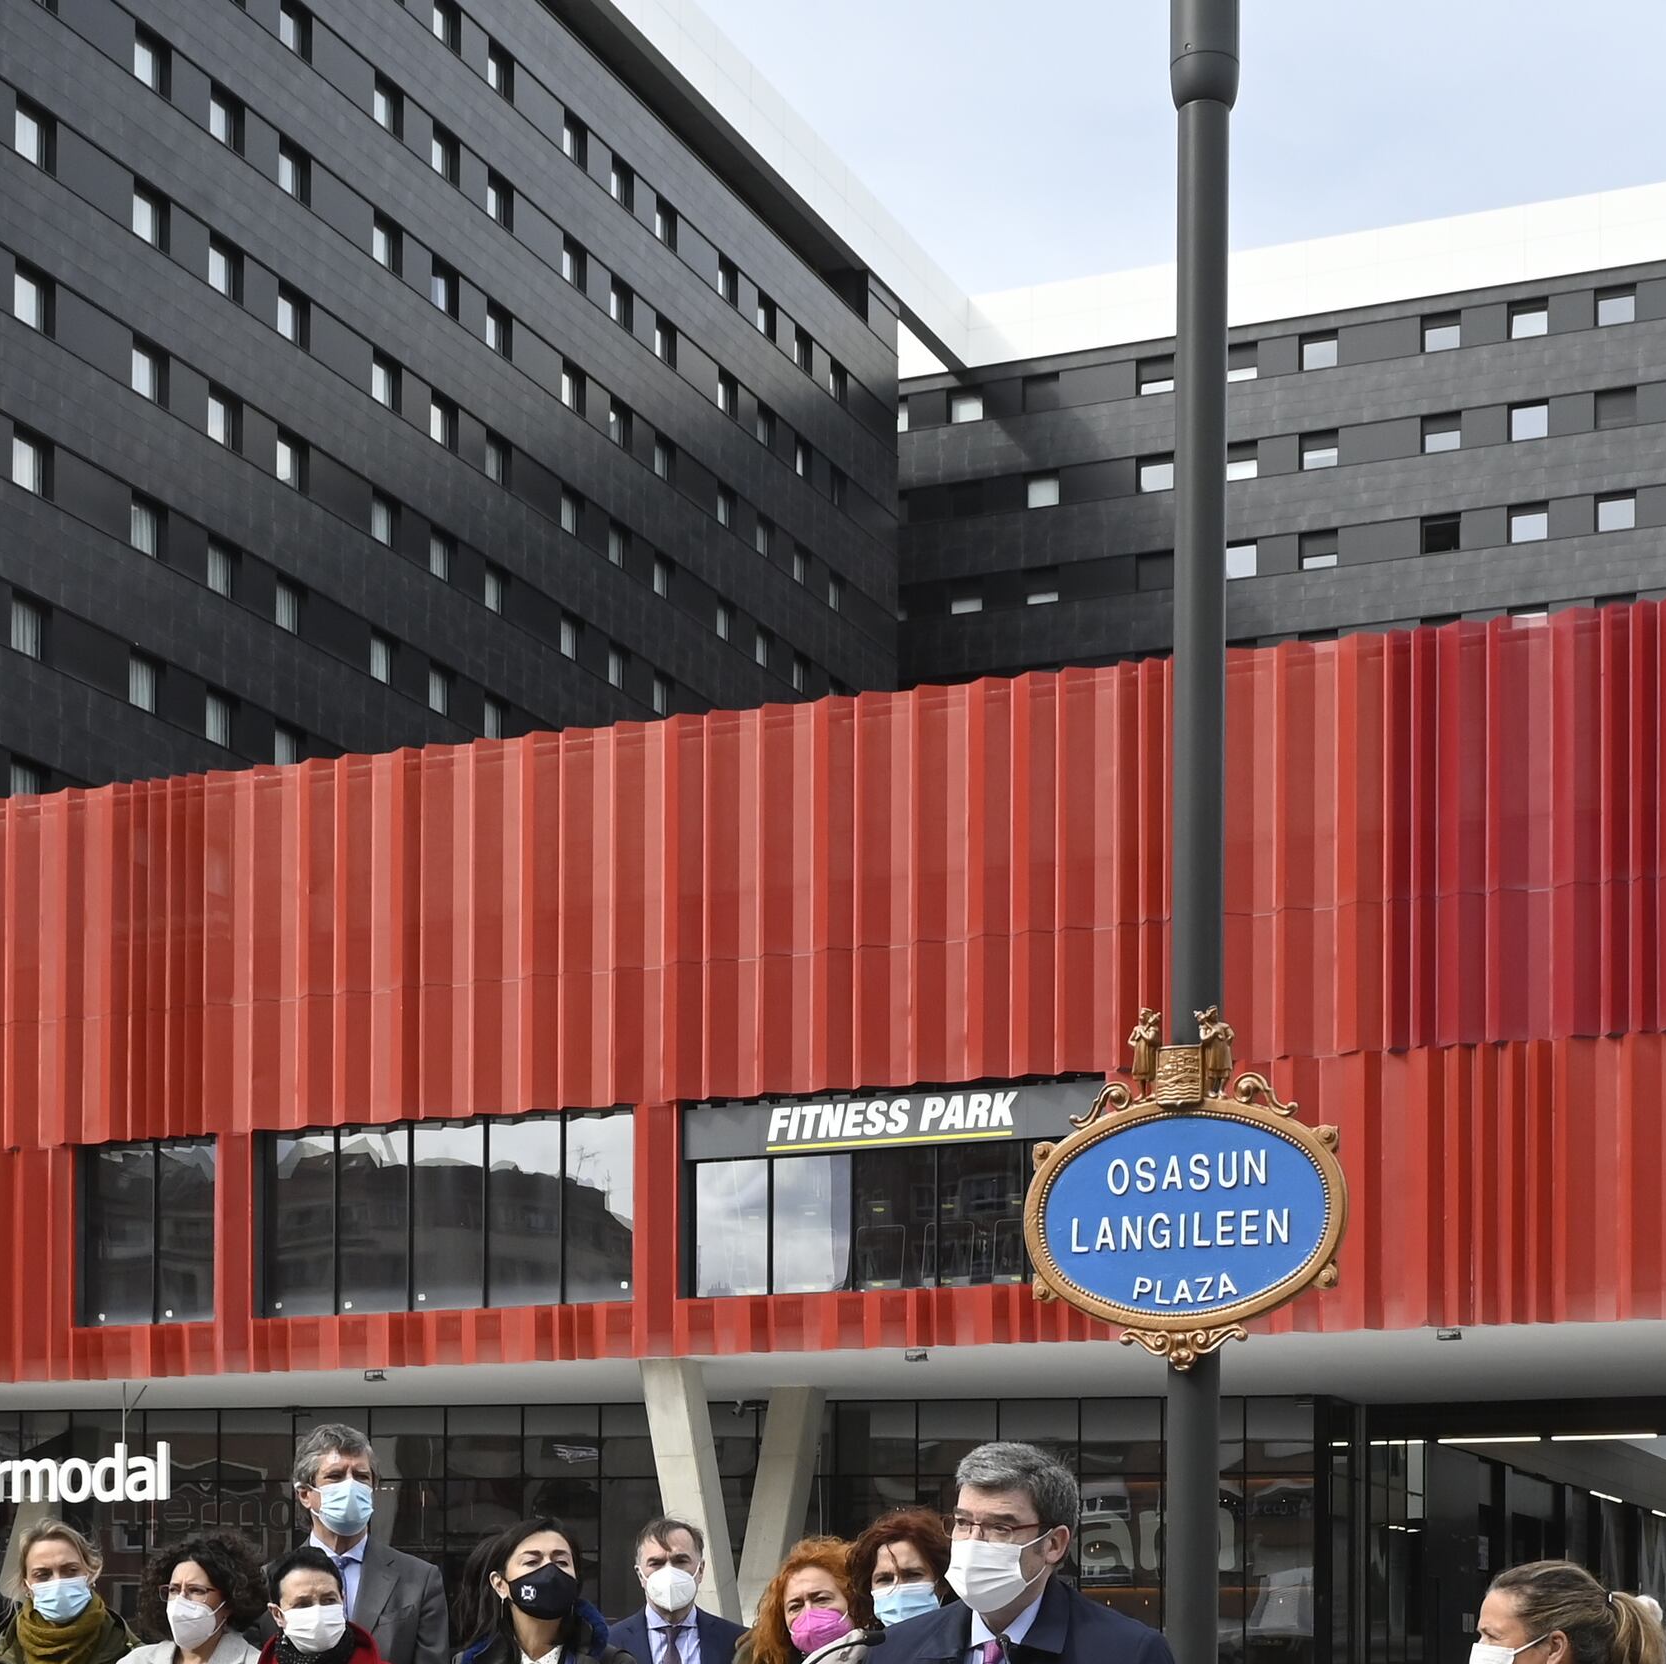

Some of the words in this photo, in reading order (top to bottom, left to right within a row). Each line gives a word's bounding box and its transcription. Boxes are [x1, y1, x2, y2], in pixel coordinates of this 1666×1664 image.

[767, 1098, 910, 1142] FITNESS
[919, 1091, 1018, 1132] PARK
[1107, 1149, 1266, 1195] OSASUN
[1071, 1208, 1290, 1253] LANGILEEN
[1133, 1273, 1238, 1305] PLAZA
